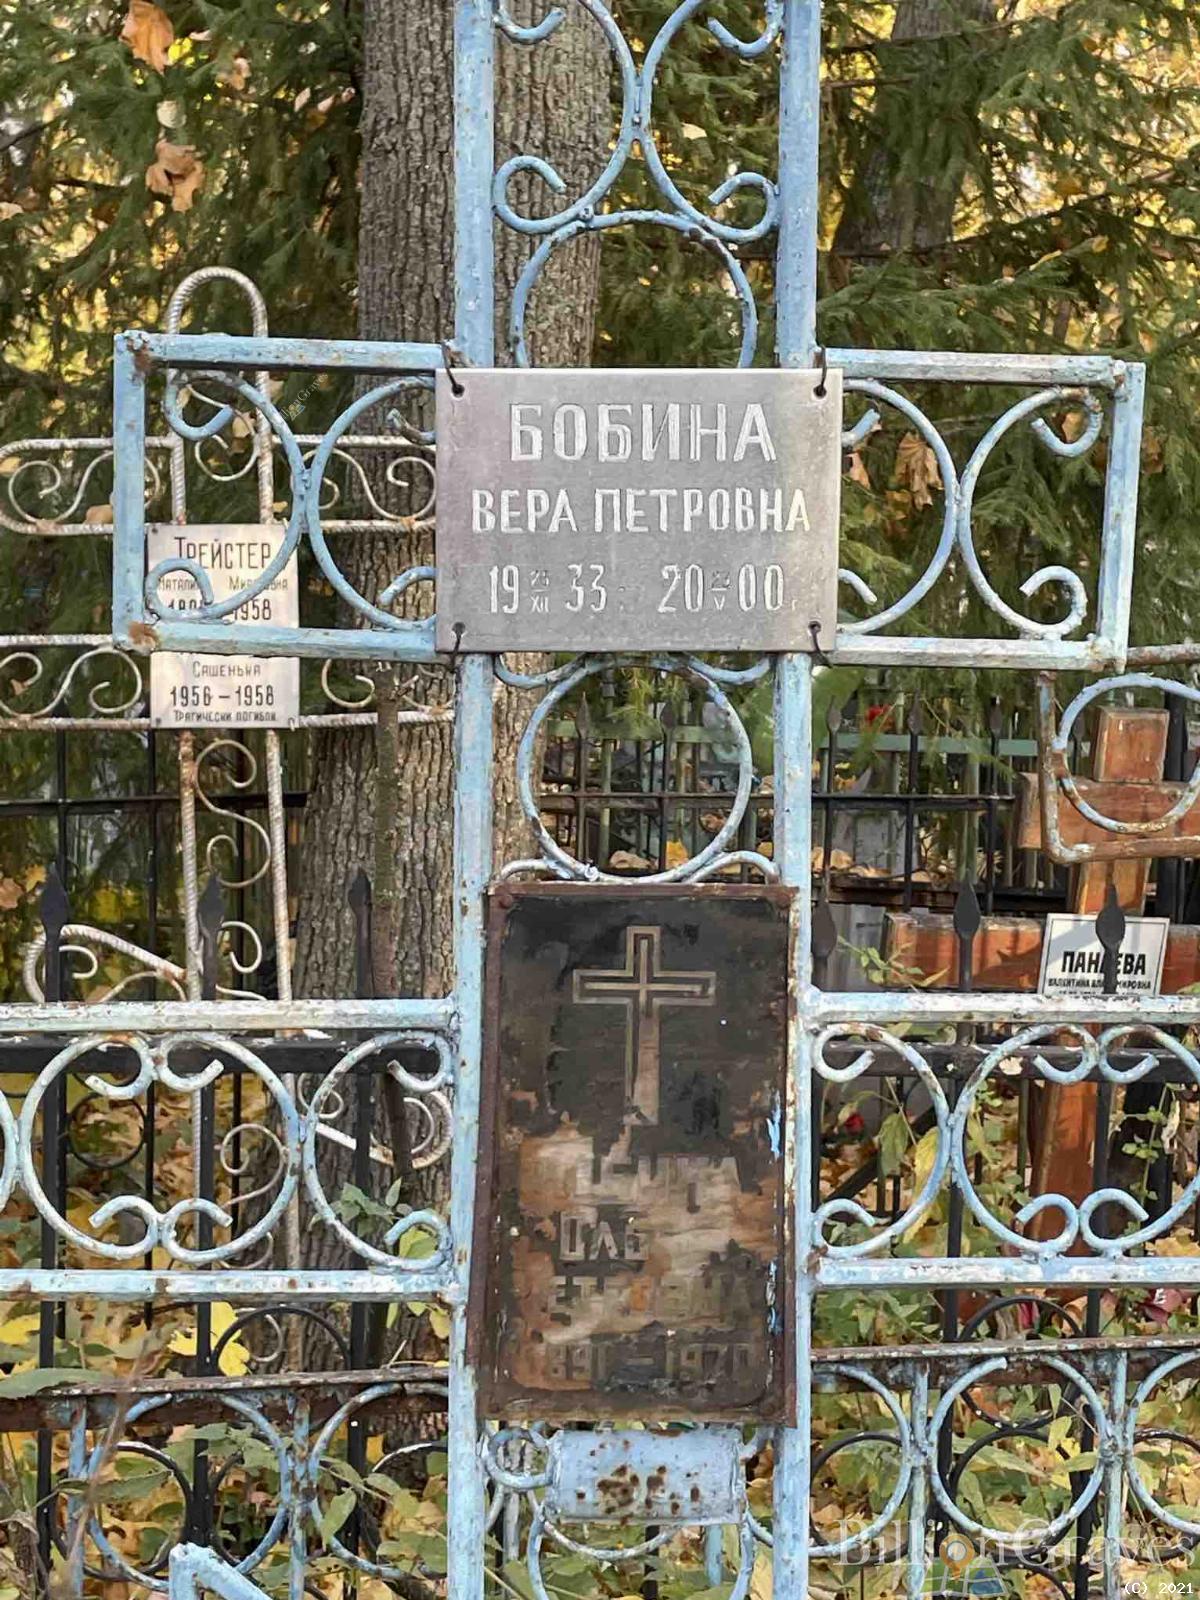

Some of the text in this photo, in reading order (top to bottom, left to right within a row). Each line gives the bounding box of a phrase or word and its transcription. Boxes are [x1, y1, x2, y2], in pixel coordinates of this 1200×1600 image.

[510, 403, 777, 462] БОБИНА
[472, 487, 811, 533] ВЕРА ПЕТРОВНА
